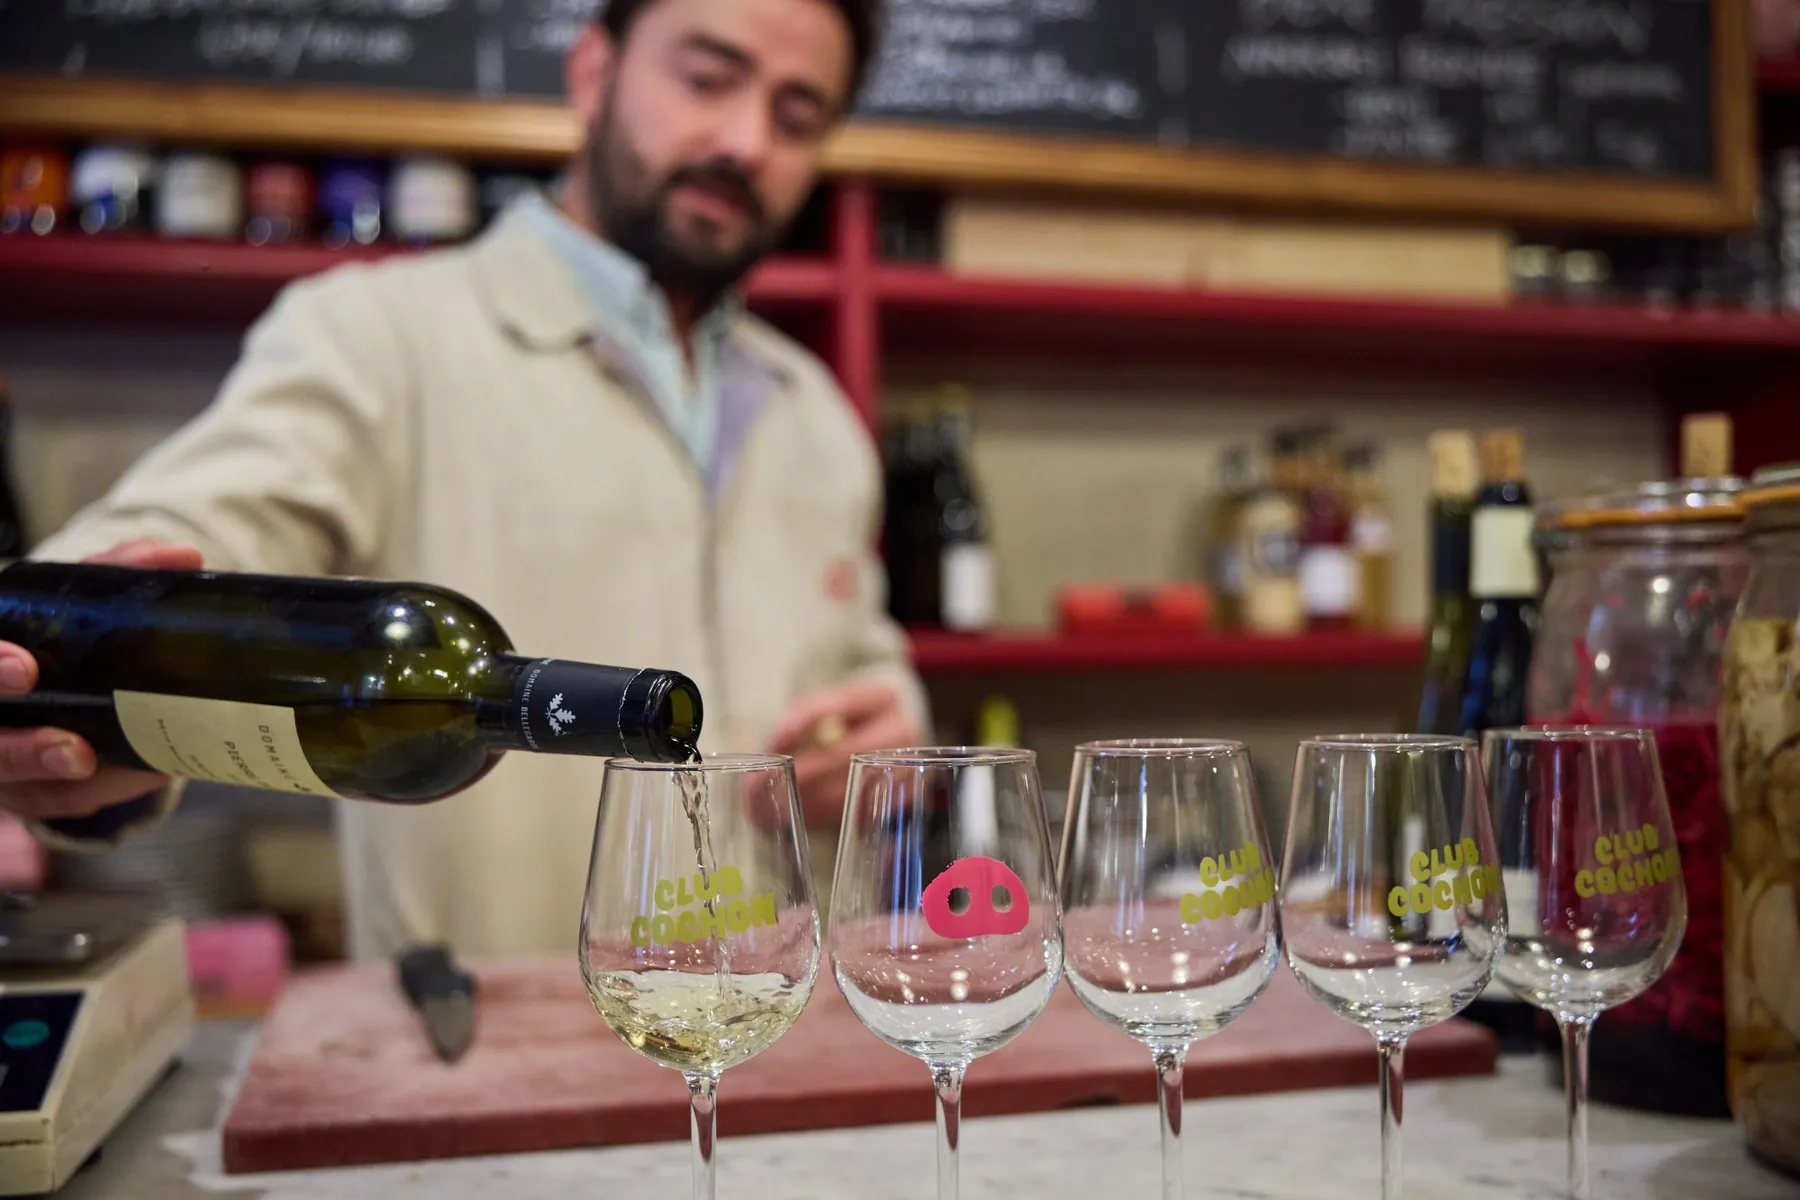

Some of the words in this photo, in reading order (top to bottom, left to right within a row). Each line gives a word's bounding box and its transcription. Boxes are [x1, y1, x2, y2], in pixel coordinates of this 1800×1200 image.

[521, 668, 541, 703] DOMAINE
[1199, 841, 1261, 888] CLUB
[1409, 836, 1480, 882] CLUB
[1594, 823, 1659, 866] CLUB
[654, 865, 744, 911] CLUB
[630, 891, 777, 947] COCHON
